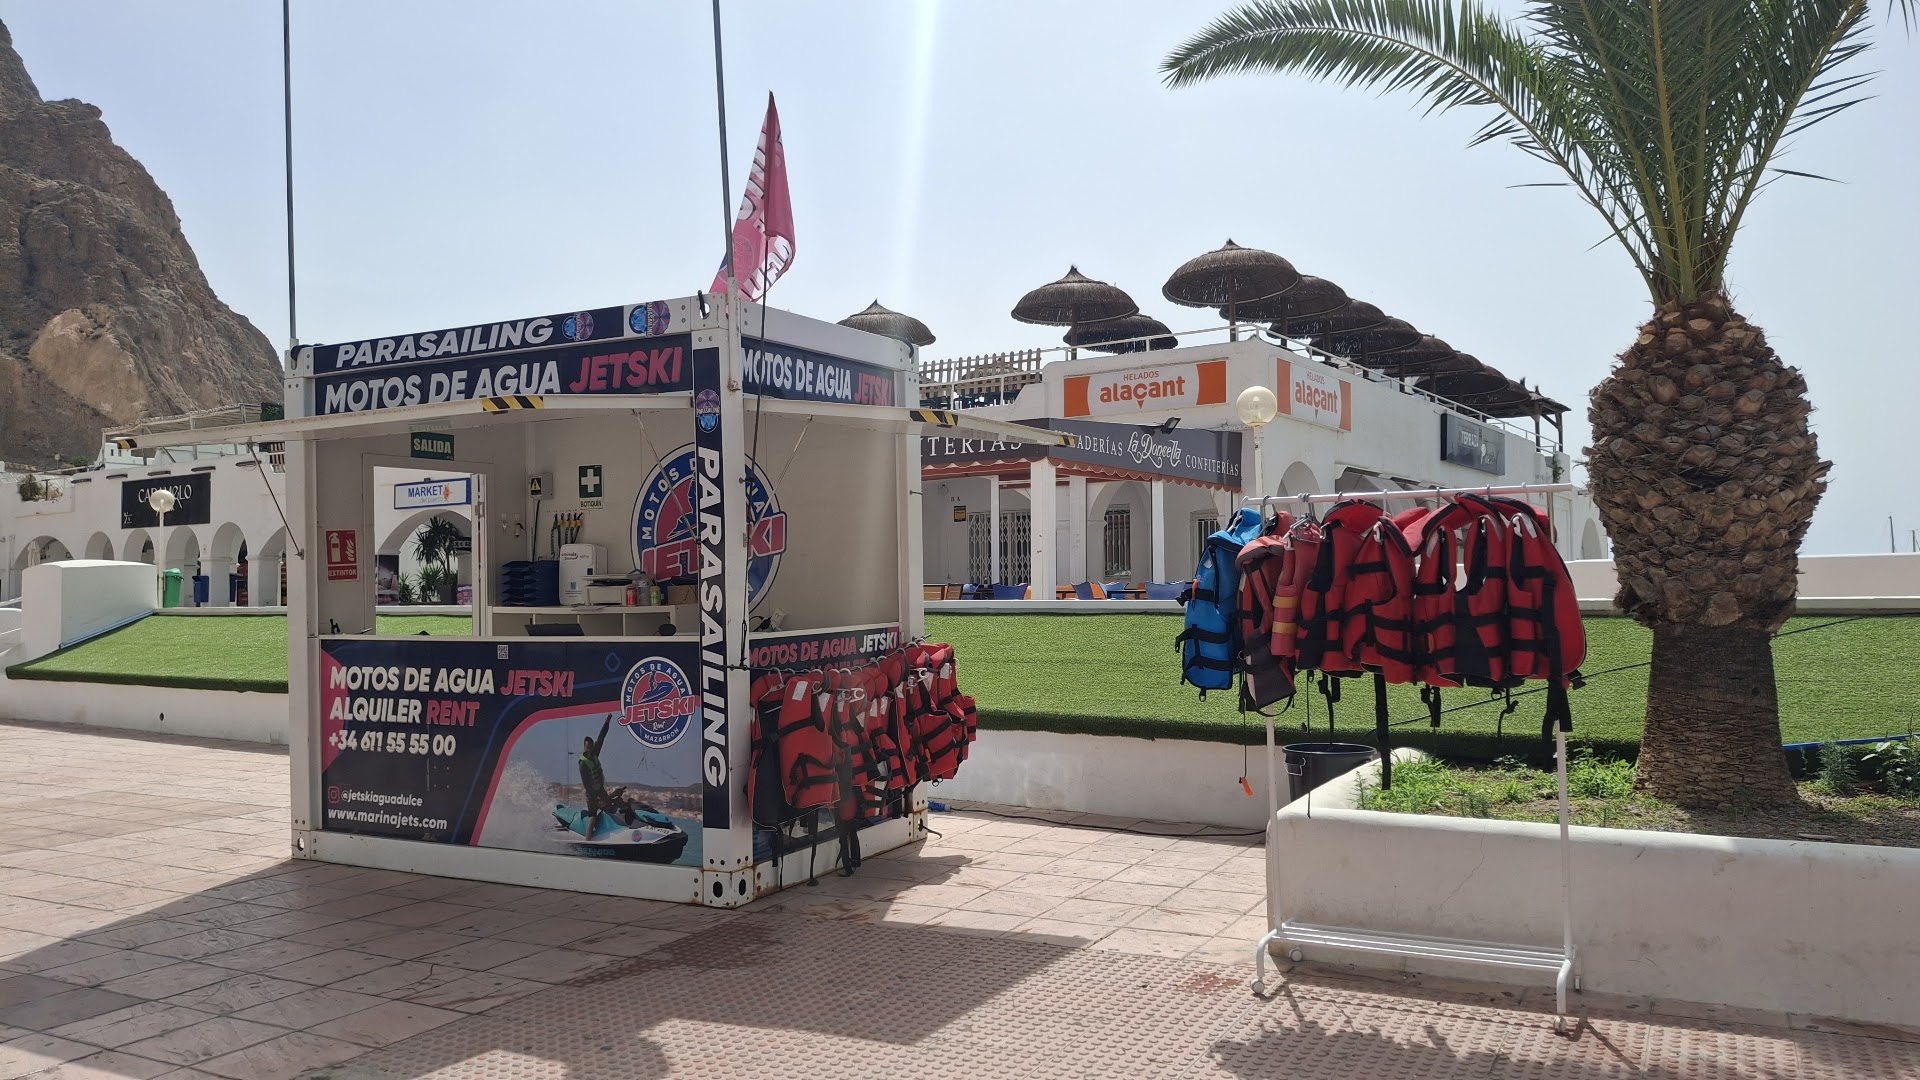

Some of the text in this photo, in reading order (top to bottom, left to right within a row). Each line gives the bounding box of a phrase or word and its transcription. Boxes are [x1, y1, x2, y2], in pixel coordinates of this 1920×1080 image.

[336, 317, 554, 368] PARASAILING
[324, 346, 684, 415] MOTOS DE AGUA JETSKI
[742, 348, 893, 407] MOTOS DE AGUA JETSKI
[1099, 375, 1186, 409] alaçant
[1123, 370, 1160, 382] HELADOS
[1295, 379, 1338, 419] alaçant
[413, 437, 452, 454] SALIDA
[1126, 431, 1143, 464] La
[1185, 454, 1240, 477] CONFITERÍAS
[408, 484, 443, 498] MARKET
[641, 467, 680, 540] MOTOS
[329, 568, 357, 577] EXTINTOR
[697, 446, 727, 788] PARASAILING
[749, 642, 798, 668] MOTOS
[800, 640, 819, 662] DE
[820, 637, 857, 659] AGUA
[859, 631, 898, 654] JETSKI
[329, 665, 575, 697] MOTOS DE AGUA JETSKI
[625, 663, 686, 703] MOTOS DE AGUA
[329, 696, 481, 727] ALQUILER RENT
[618, 694, 696, 726] JETSKI
[652, 721, 667, 731] Rent
[329, 729, 457, 757] +34 611 55 55 00
[644, 727, 680, 743] MAZARRON
[341, 789, 423, 806] @jetskiaguadulce
[328, 808, 448, 830] www.marinajets.com
